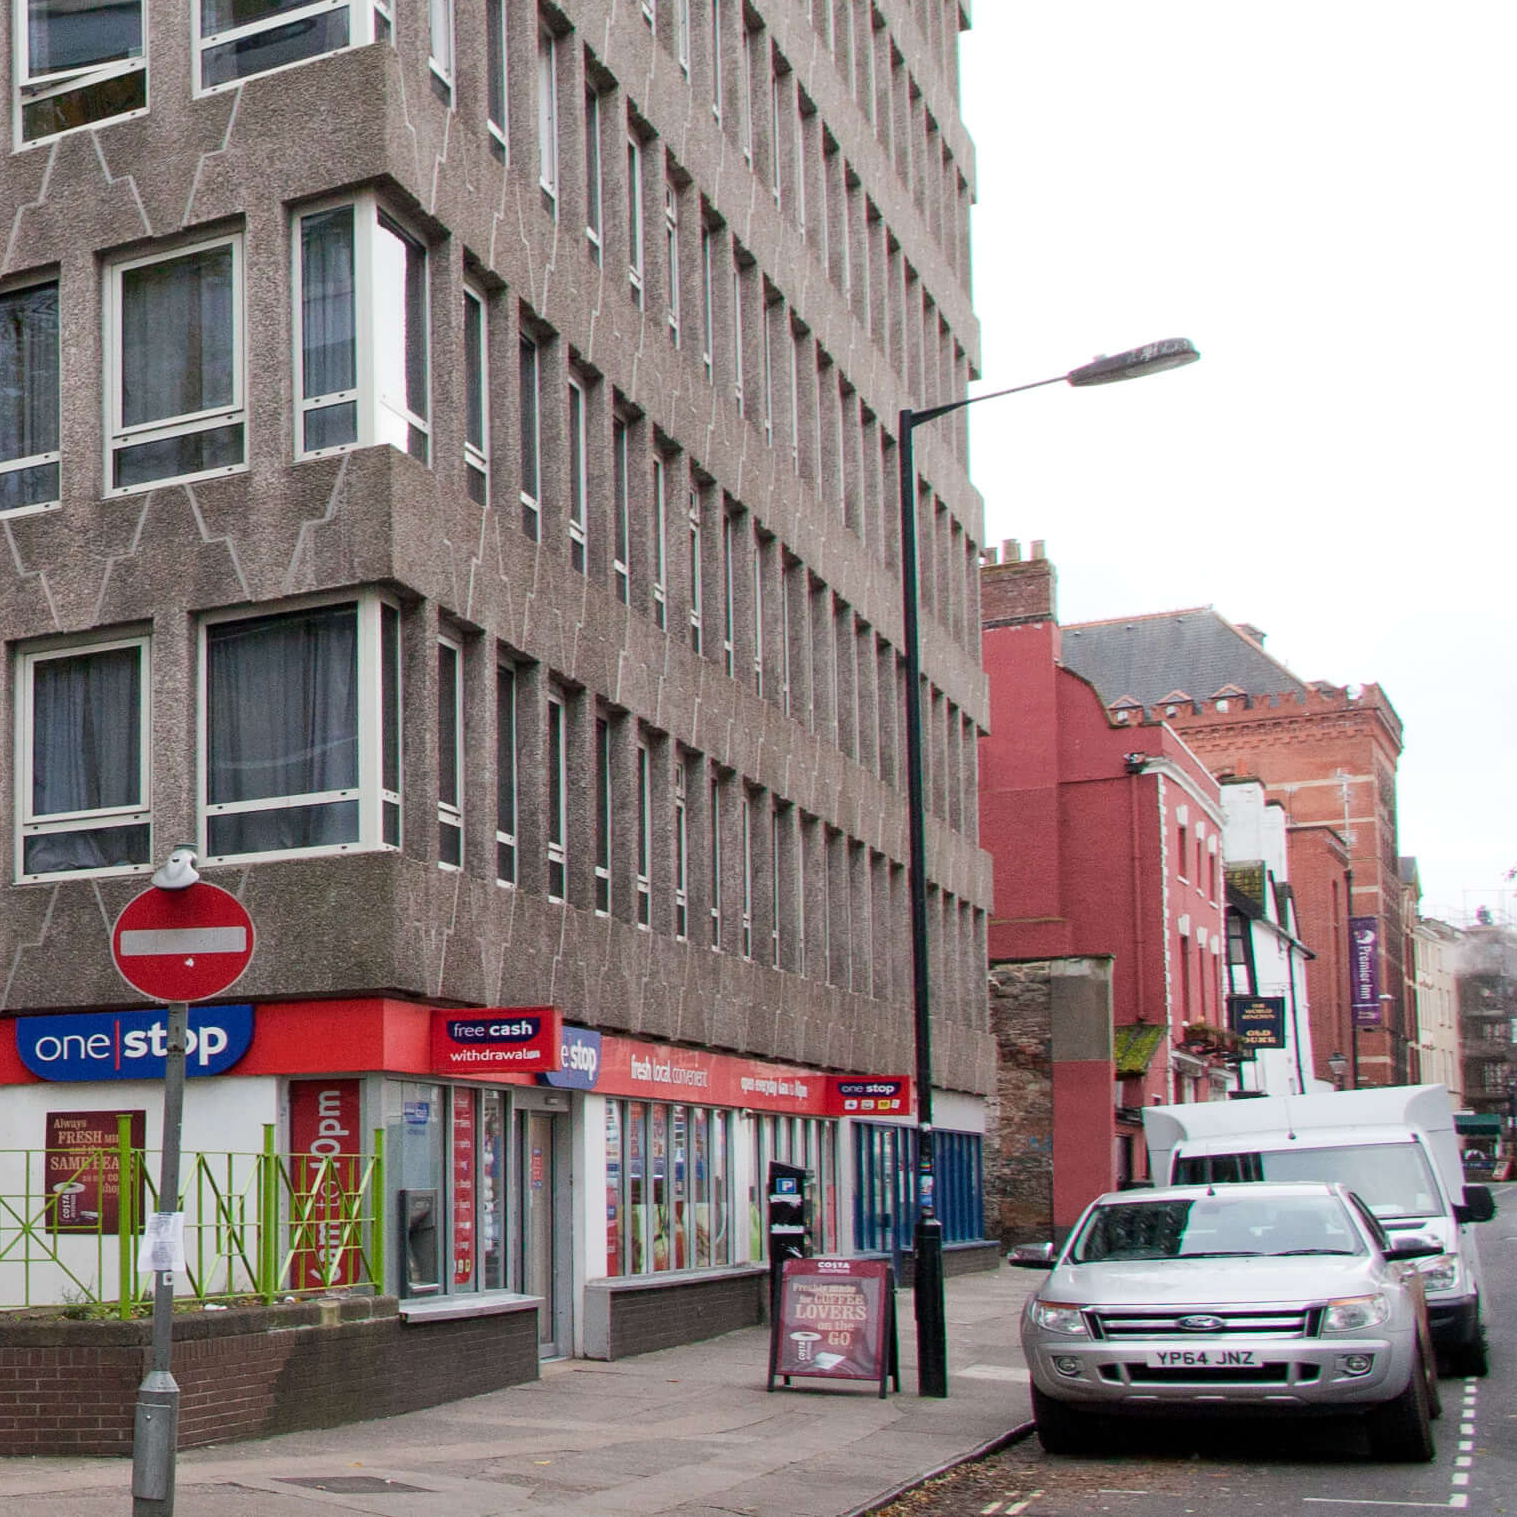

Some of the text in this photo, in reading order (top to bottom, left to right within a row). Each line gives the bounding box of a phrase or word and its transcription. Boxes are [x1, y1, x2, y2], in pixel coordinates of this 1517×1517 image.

[1358, 945, 1373, 981] Premier
[1359, 984, 1373, 999] Inn
[454, 1020, 533, 1037] free cash
[35, 1033, 111, 1062] one
[570, 1039, 597, 1081] stop
[630, 1053, 652, 1081] fresh
[653, 1057, 671, 1083] local
[841, 1083, 895, 1095] one stop
[53, 1118, 87, 1130] Always
[310, 1090, 350, 1169] 10pm
[58, 1130, 103, 1143] FRESH
[315, 1180, 341, 1207] to
[61, 1194, 71, 1219] COSTA
[817, 1261, 850, 1269] COSTA
[814, 1293, 865, 1305] COFFEE
[795, 1304, 867, 1320] LOVERS
[817, 1320, 854, 1331] on the
[828, 1331, 851, 1346] GO
[797, 1341, 806, 1361] COSTA
[1156, 1351, 1255, 1365] YP64 JNZ
